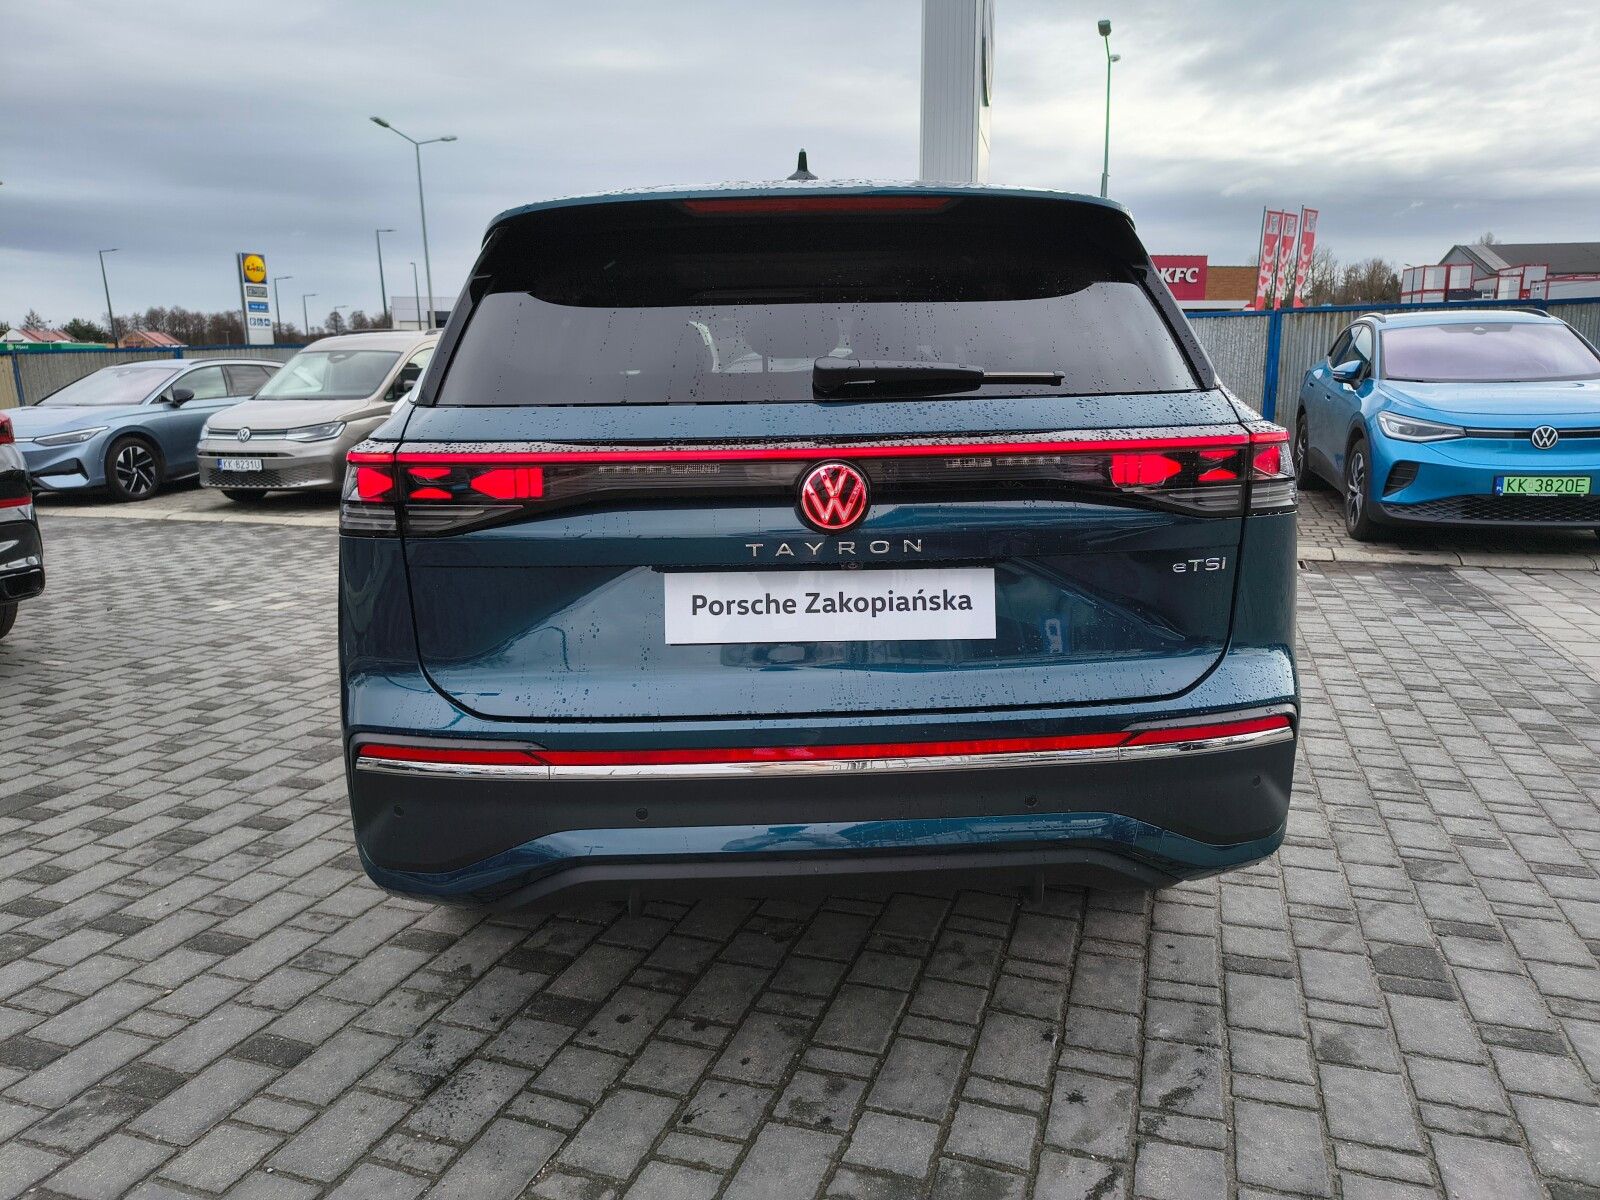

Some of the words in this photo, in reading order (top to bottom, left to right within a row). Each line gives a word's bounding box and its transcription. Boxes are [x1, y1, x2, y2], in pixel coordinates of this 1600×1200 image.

[1159, 267, 1199, 283] KFC
[235, 459, 260, 470] 8231U
[1507, 478, 1527, 492] KK
[1534, 478, 1586, 492] 3820E
[745, 538, 923, 557] TAYRON
[691, 593, 797, 615] Porsche
[805, 587, 973, 618] Zakopiańska
